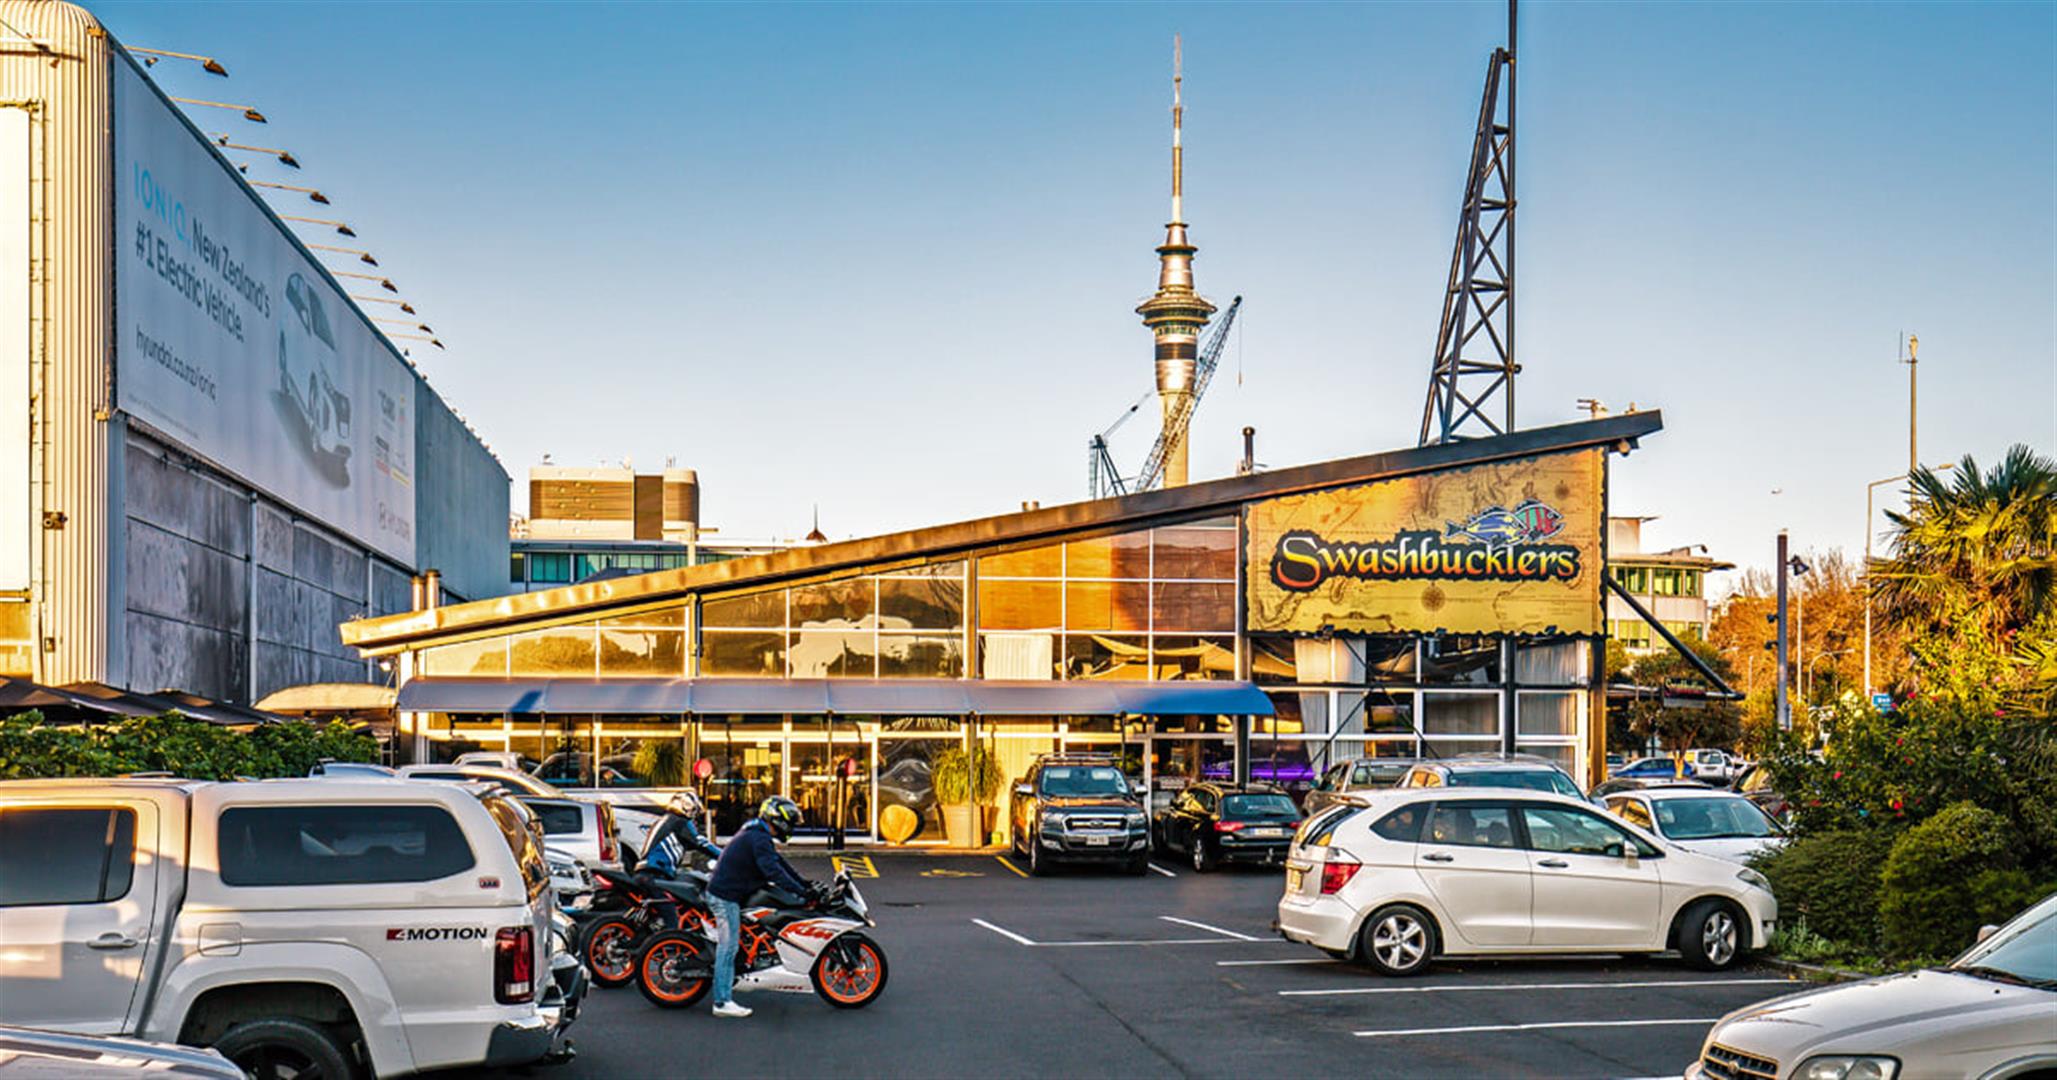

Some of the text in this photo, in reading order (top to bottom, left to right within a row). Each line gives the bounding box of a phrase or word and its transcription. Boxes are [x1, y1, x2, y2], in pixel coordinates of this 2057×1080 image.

[136, 219, 244, 343] #1 Electric Vehicle.
[192, 217, 221, 272] New
[222, 245, 270, 319] Zealand's
[1277, 535, 1576, 587] Swashbucklers
